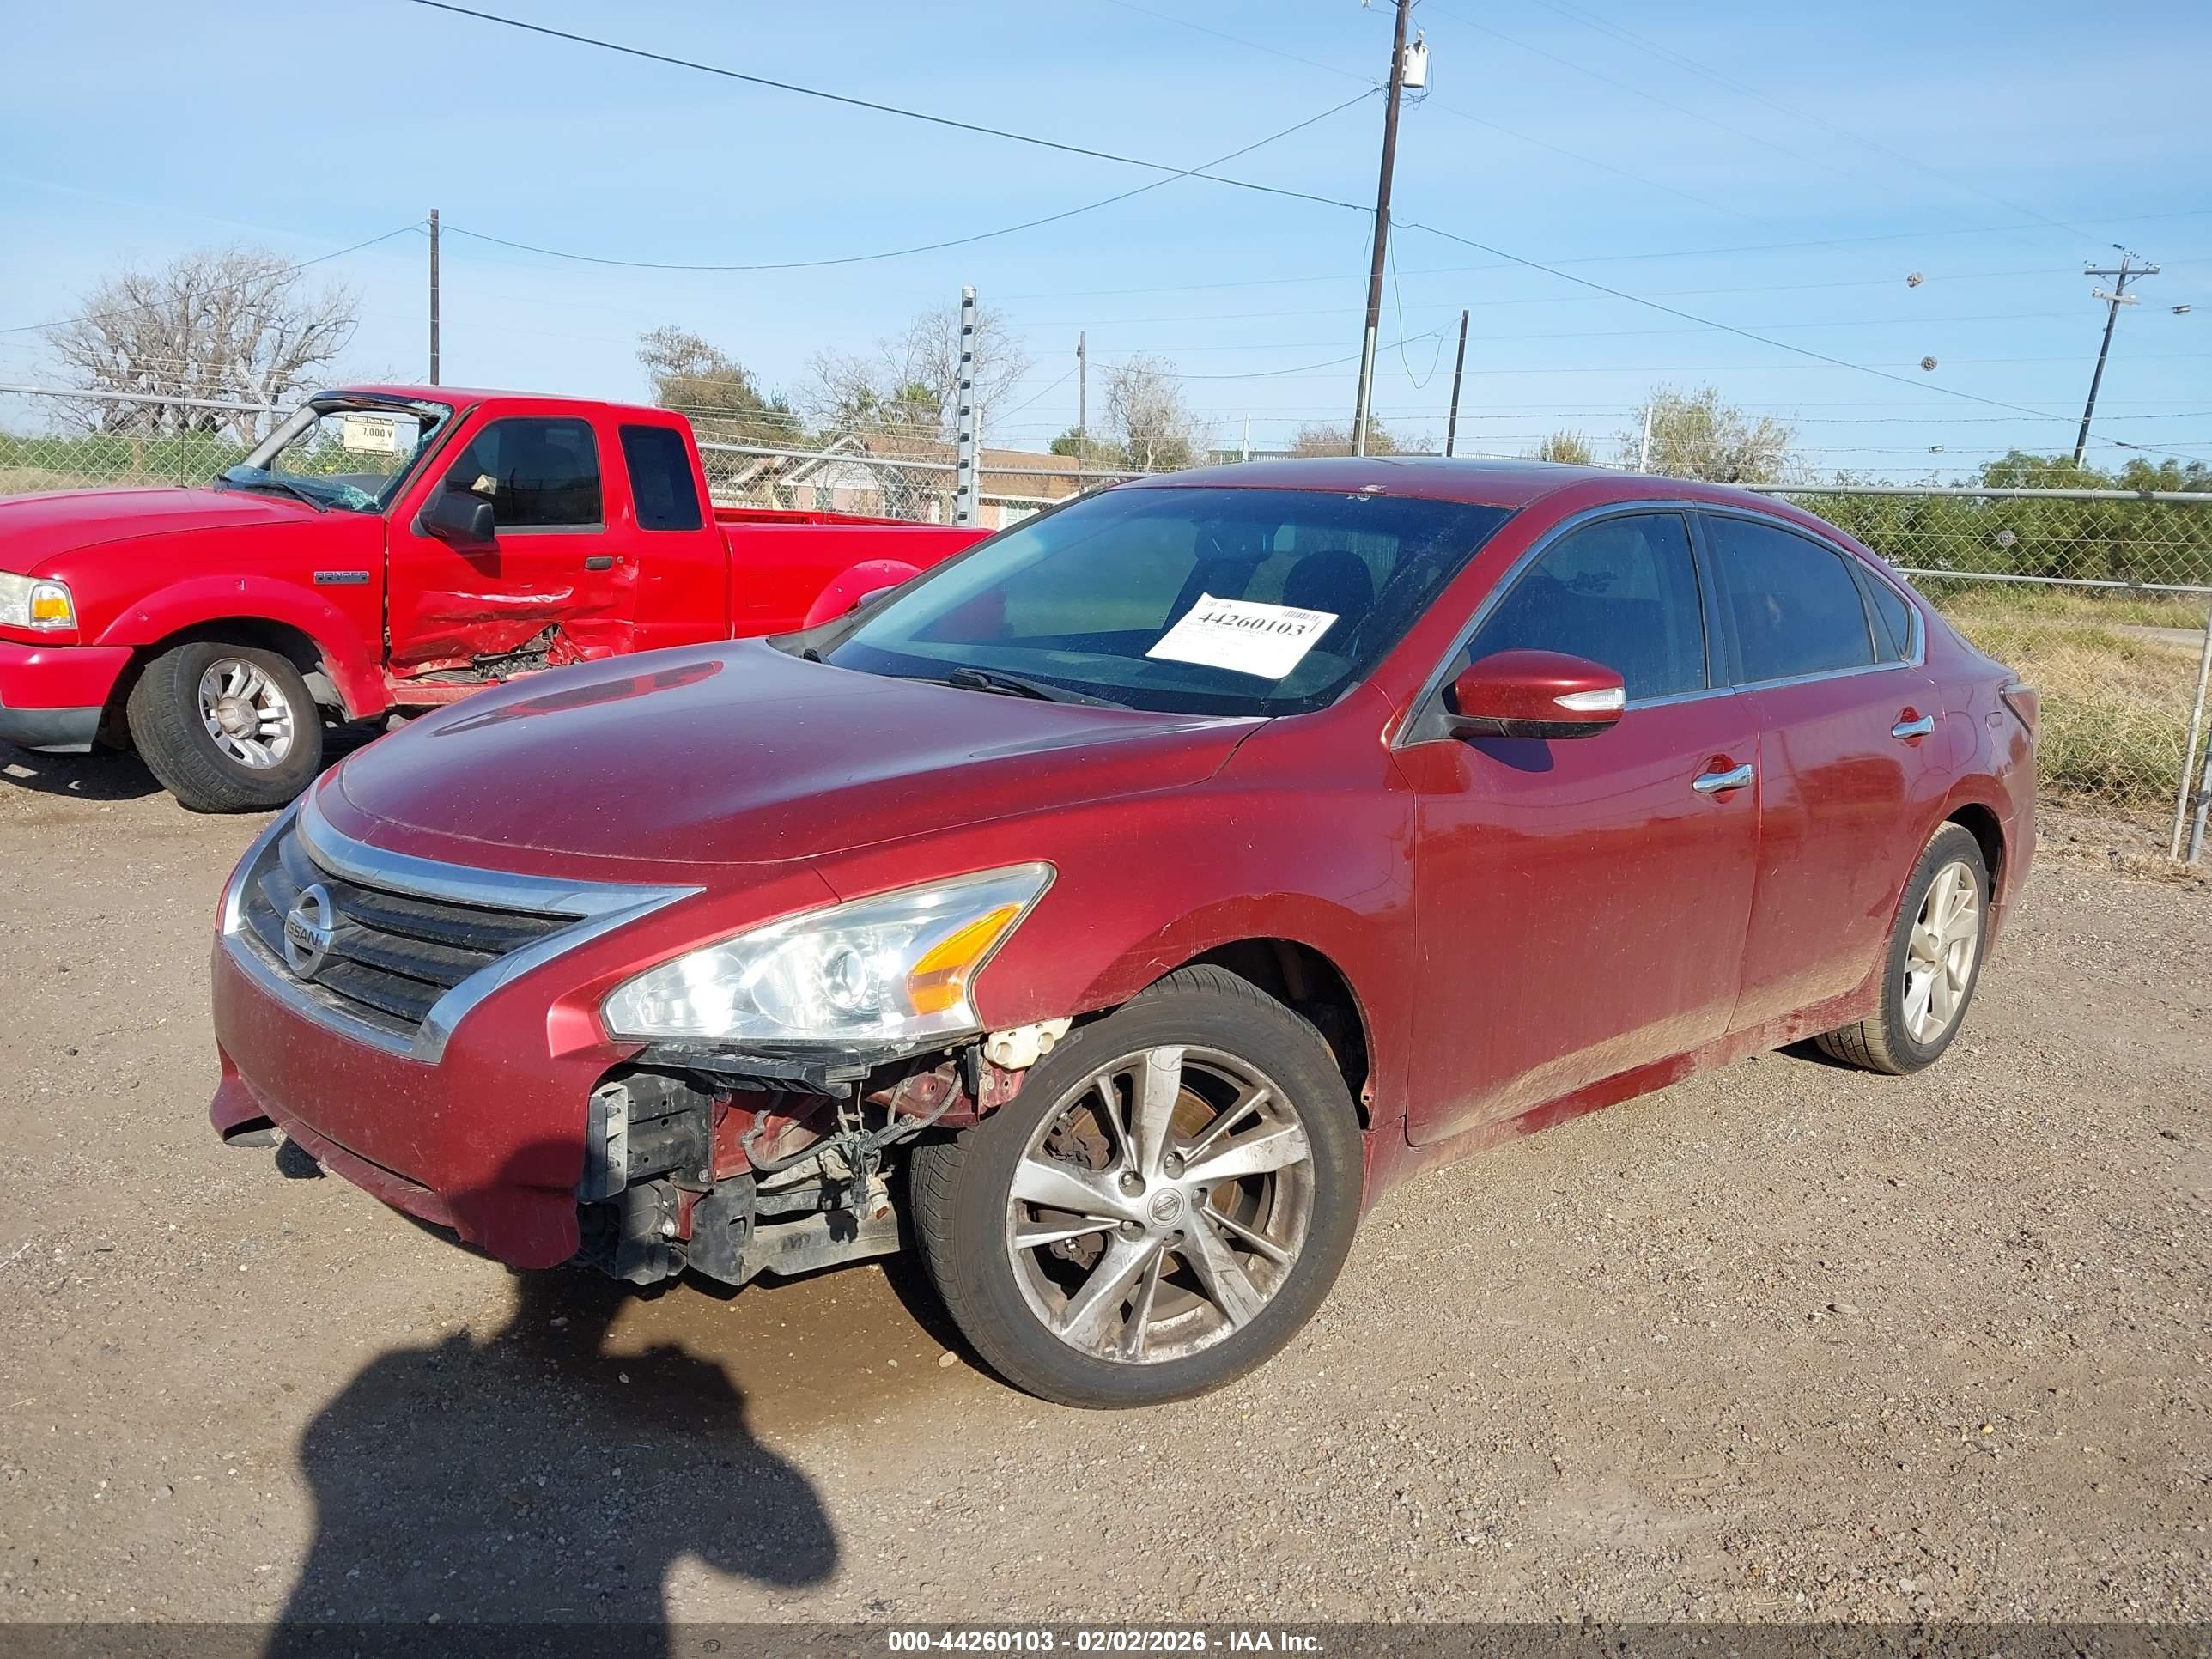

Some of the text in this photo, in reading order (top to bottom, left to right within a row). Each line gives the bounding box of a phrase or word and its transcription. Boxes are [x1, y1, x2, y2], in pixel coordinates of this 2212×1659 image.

[362, 427, 392, 438] 7,000 V
[1198, 611, 1307, 637] 44260103
[286, 920, 319, 946] ISSAN
